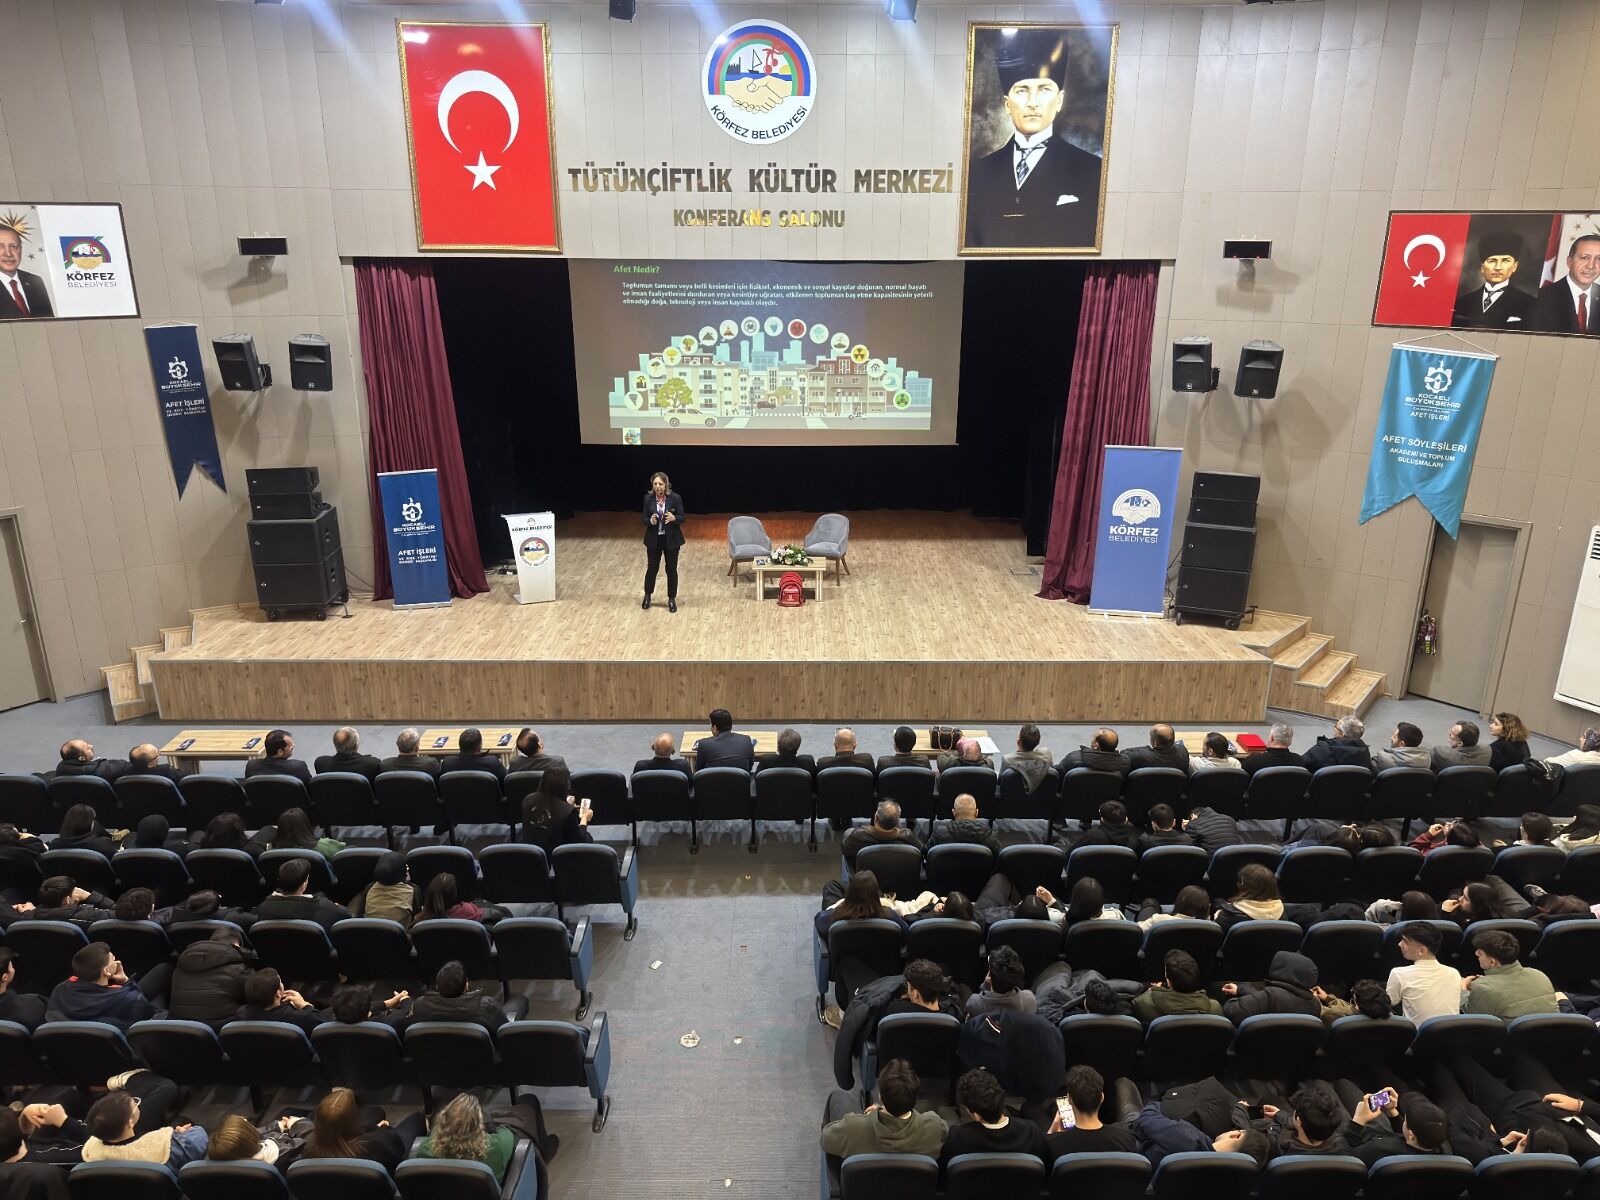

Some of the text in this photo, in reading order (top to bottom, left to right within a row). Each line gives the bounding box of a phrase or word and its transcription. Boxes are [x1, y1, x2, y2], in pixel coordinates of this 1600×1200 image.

[711, 105, 807, 139] KÖRFEZ BELEDİYESİ
[568, 161, 953, 196] TÜTÜNÇİFTLİK KÜLTÜR MERKEZİ
[673, 209, 845, 228] KONFERANS SALONU
[613, 265, 660, 274] Afet Nedir?
[66, 271, 115, 280] KÖRFEZ
[622, 282, 652, 290] Toplumun
[648, 290, 686, 298] faaliyetlerini
[622, 298, 650, 306] olmadığı
[669, 298, 696, 306] teknoloji
[1383, 435, 1467, 452] AFET SÖYLEŞİLERİ
[1429, 453, 1455, 461] TOPLUM
[1109, 525, 1159, 536] KÖRFEZ
